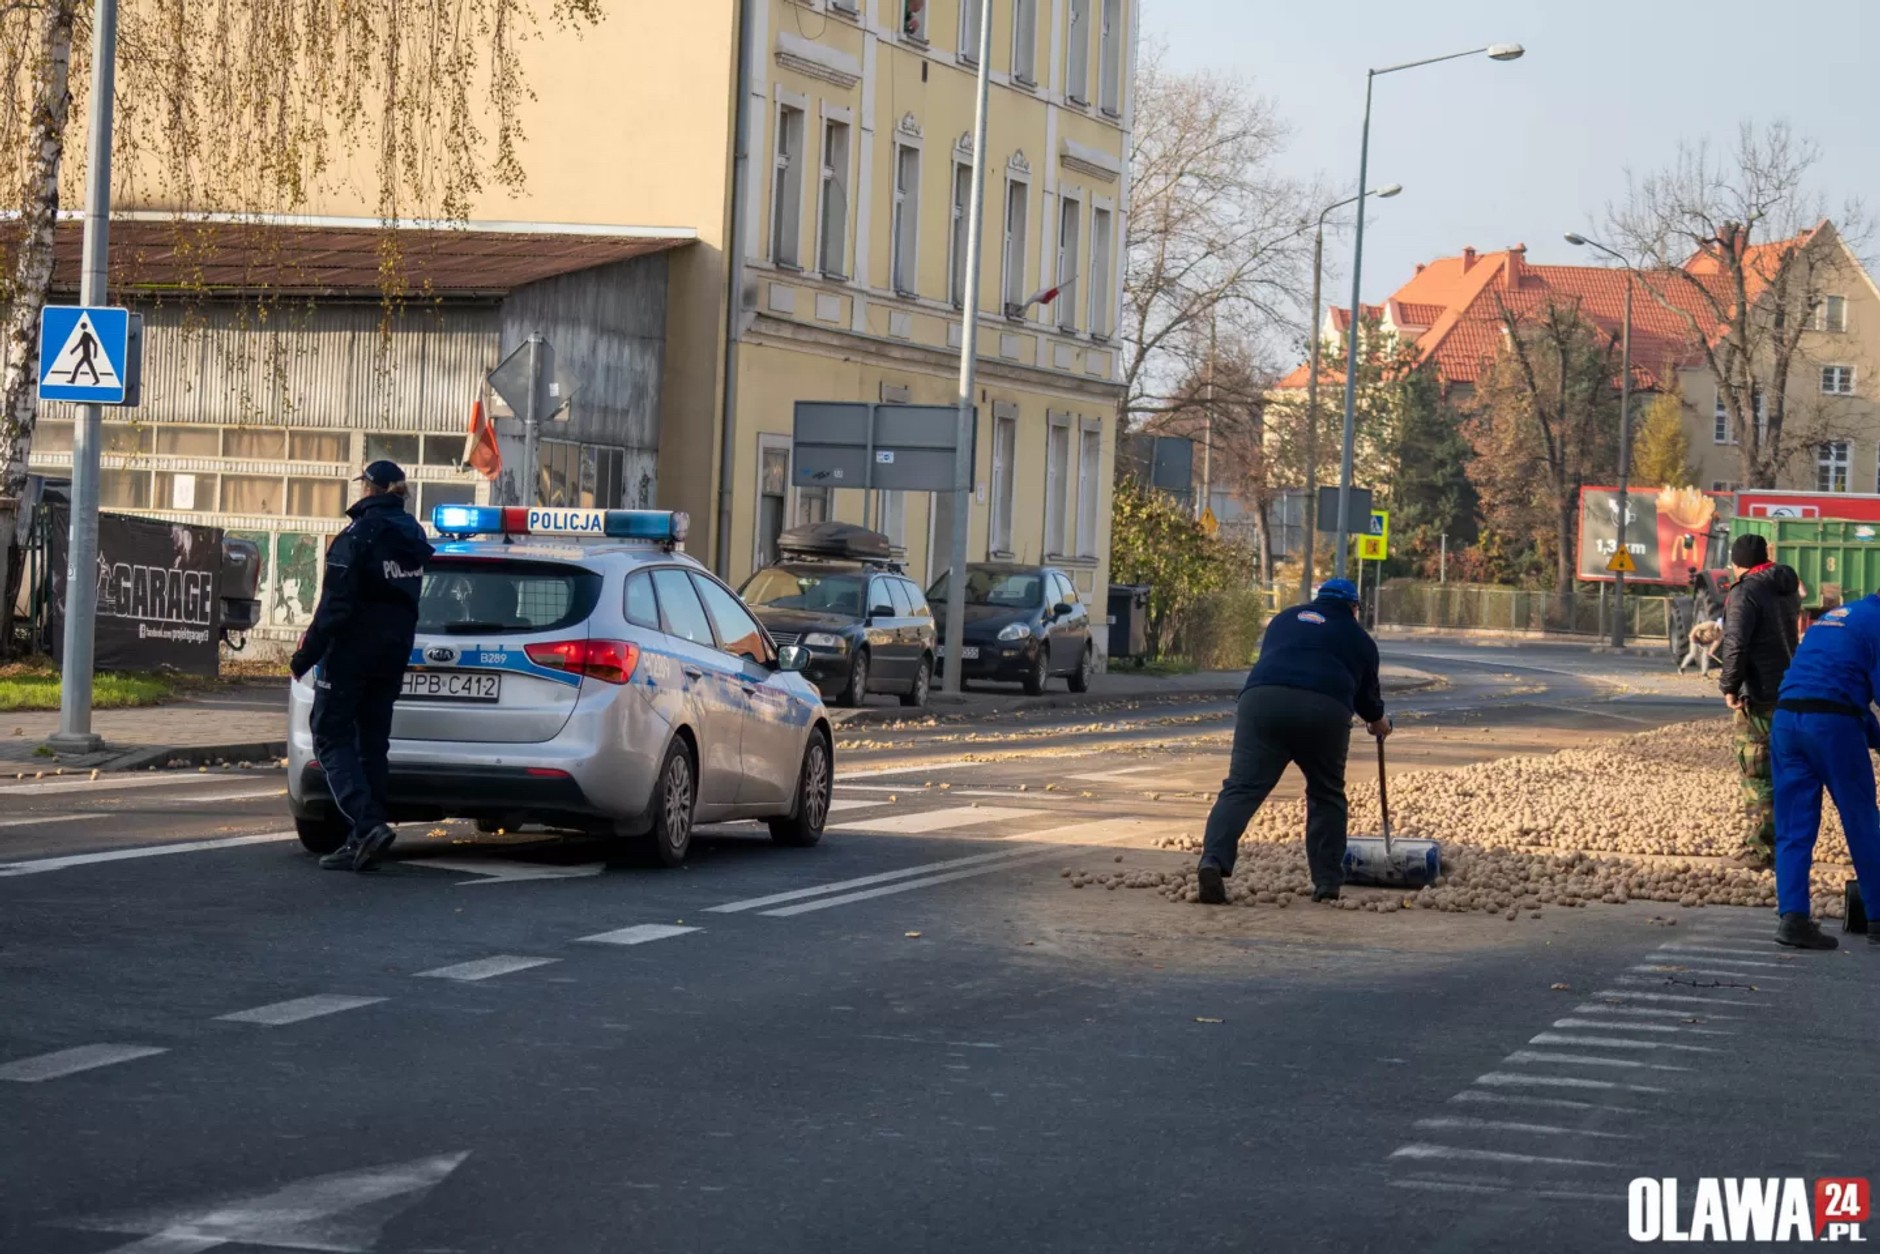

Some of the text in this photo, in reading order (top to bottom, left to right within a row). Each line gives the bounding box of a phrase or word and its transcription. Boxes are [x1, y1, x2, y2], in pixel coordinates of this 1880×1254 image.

[530, 511, 602, 531] POLICJA
[113, 562, 212, 625] GARAGE
[430, 649, 454, 661] KIA
[480, 652, 507, 664] B289
[400, 673, 496, 696] HPB C412
